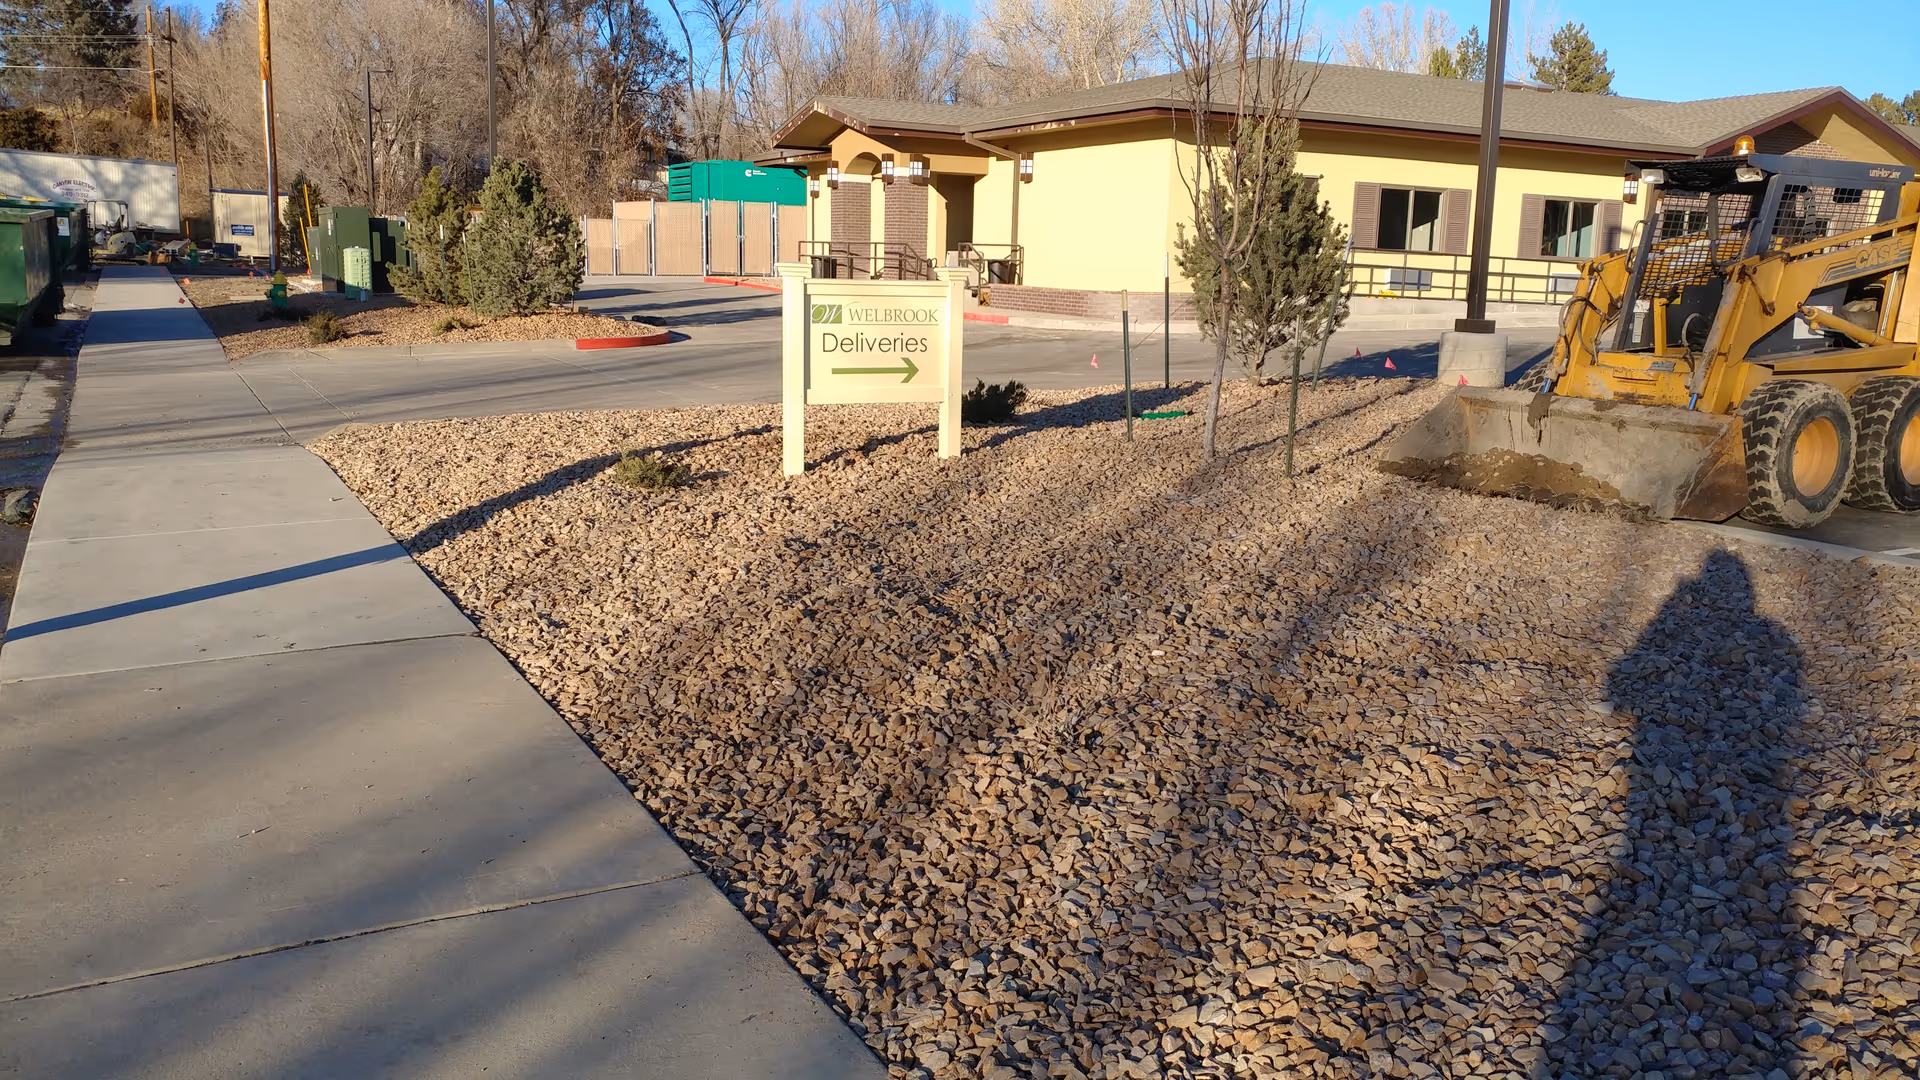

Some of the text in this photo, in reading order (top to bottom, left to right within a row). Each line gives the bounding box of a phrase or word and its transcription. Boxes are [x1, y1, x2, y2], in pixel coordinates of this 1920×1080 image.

[53, 180, 72, 189] CANYON
[1855, 240, 1902, 270] CASE
[849, 308, 939, 323] WELBROOK
[822, 332, 928, 353] Deliveries
